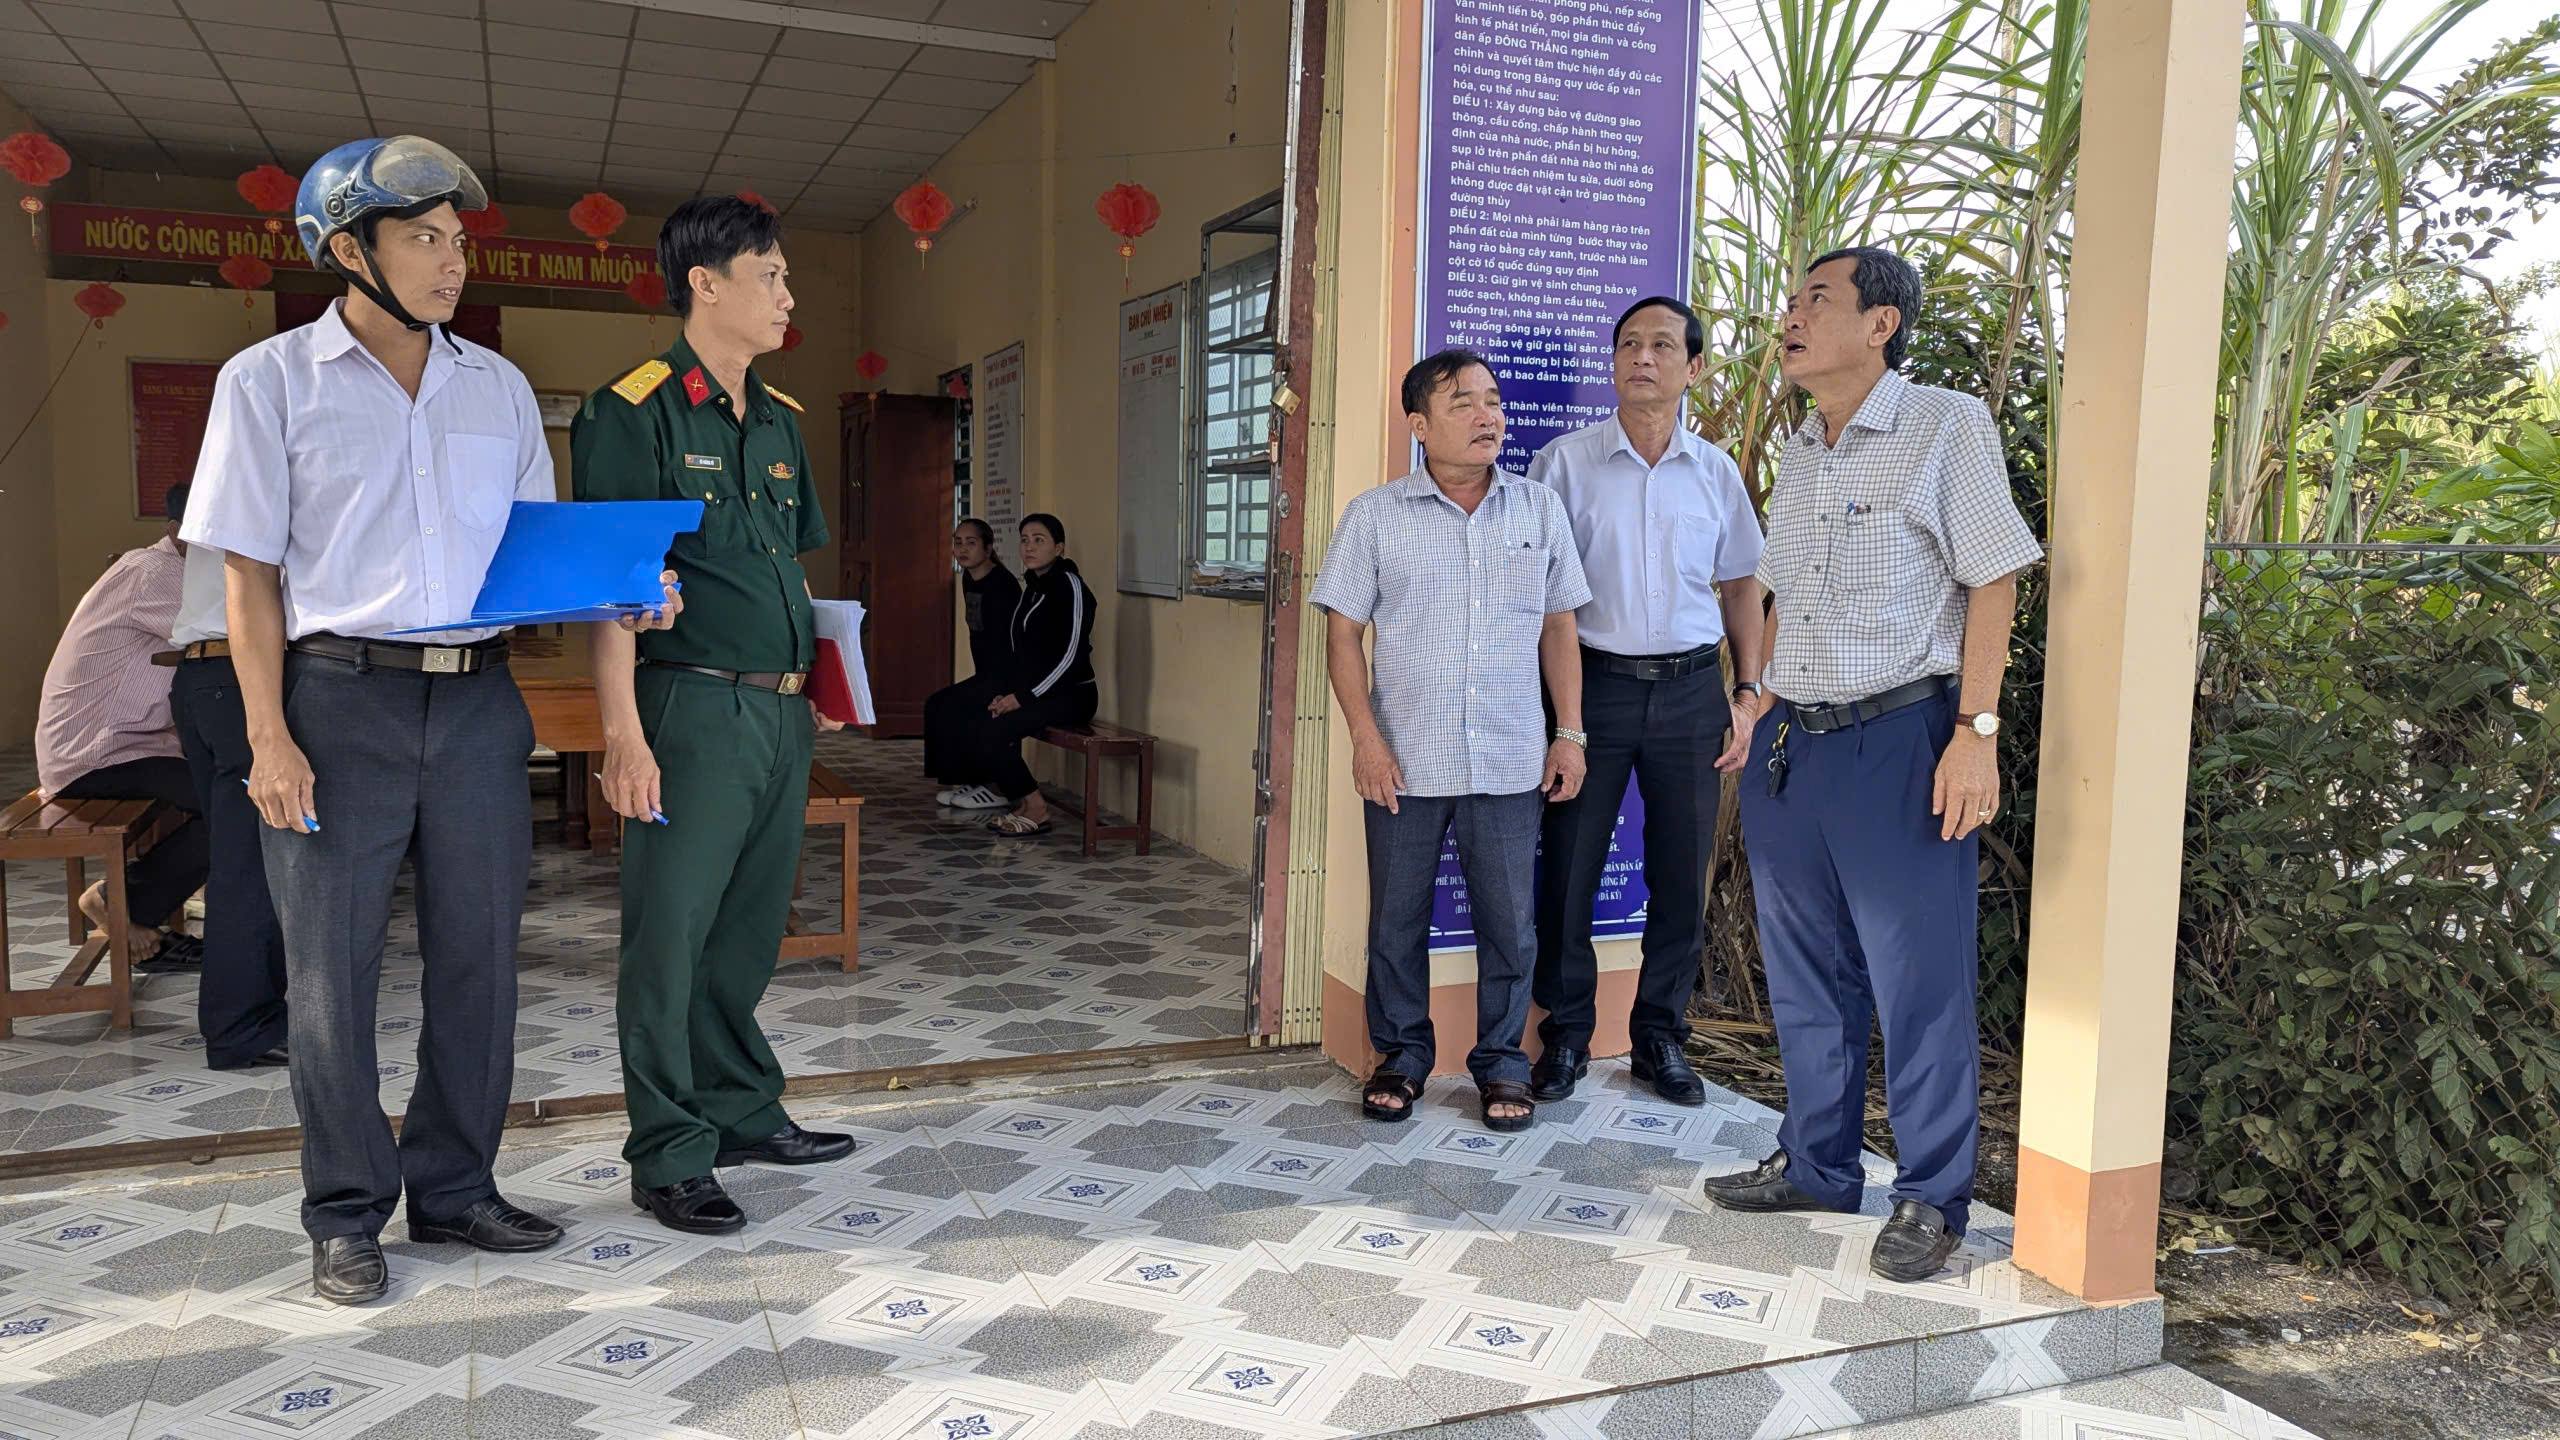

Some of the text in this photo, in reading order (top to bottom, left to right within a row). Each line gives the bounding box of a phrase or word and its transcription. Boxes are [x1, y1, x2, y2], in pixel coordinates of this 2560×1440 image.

[1478, 0, 1505, 14] minh
[1549, 11, 1570, 25] góp
[1601, 18, 1625, 31] thúc
[1590, 3, 1612, 14] phú,
[1454, 12, 1479, 26] kinh
[1494, 19, 1519, 32] phát
[1550, 29, 1571, 41] mọi
[1572, 31, 1589, 43] gia
[1616, 36, 1629, 48] và
[1631, 39, 1657, 54] công
[1454, 29, 1476, 42] dân
[1570, 47, 1610, 61] nghiêm
[1487, 50, 1500, 62] và
[1534, 57, 1554, 70] tâm
[1644, 72, 1663, 84] các
[1453, 78, 1537, 99] hóa, cụ như
[1473, 65, 1501, 80] dung
[1503, 69, 1532, 84] trong
[1563, 79, 1584, 91] quy
[1622, 85, 1641, 96] văn
[1483, 98, 1493, 109] 1:
[1495, 99, 1516, 114] Xây
[1547, 106, 1568, 118] bảo
[1619, 116, 1642, 128] giao
[1451, 111, 1487, 126] thông,
[1571, 125, 1598, 138] hành
[1599, 129, 1623, 141] theo
[1624, 133, 1644, 145] quy
[1451, 127, 1476, 140] định
[1478, 129, 1499, 142] của
[1500, 133, 1521, 145] nhà
[1583, 142, 1594, 155] bị
[1595, 143, 1610, 155] hư
[1451, 144, 1472, 157] sụp
[1487, 147, 1509, 159] trên
[1560, 156, 1580, 167] nhà
[1582, 158, 1602, 170] nào
[1619, 162, 1639, 174] nhà
[1641, 164, 1655, 175] đó
[1450, 159, 1475, 172] phải
[1477, 162, 1501, 175] chịu
[1502, 165, 1530, 177] trách
[1567, 172, 1578, 183] tu
[1628, 179, 1654, 193] sông
[1450, 175, 1485, 191] không
[1592, 190, 1615, 203] giao
[1616, 192, 1646, 207] thông
[1479, 210, 1651, 236] 2: Mọi nhà phải làm hàng trên
[228, 223, 274, 259] HÒA
[1499, 227, 1519, 239] của
[1520, 230, 1547, 242] mình
[1605, 238, 1628, 251] thay
[1629, 240, 1649, 251] vào
[1448, 239, 1477, 254] hàng
[1528, 246, 1547, 260] cây
[1548, 249, 1577, 262] xanh,
[1608, 253, 1627, 265] nhà
[1629, 255, 1648, 266] làm
[539, 254, 583, 282] NAM
[1525, 262, 1553, 276] đúng
[1554, 266, 1574, 278] quy
[1576, 266, 1599, 278] định
[1477, 273, 1488, 284] 3:
[1545, 279, 1568, 291] sinh
[1570, 281, 1602, 295] chung
[1604, 283, 1624, 295] bảo
[1476, 290, 1506, 303] sạch,
[1507, 291, 1541, 306] không
[1542, 294, 1562, 305] làm
[1585, 297, 1608, 310] tiêu,
[1128, 313, 1140, 332] BAN
[1489, 306, 1616, 326] trại, nhà và rác,
[1504, 323, 1531, 336] sông
[1532, 324, 1553, 338] gây
[1554, 325, 1562, 336] ô
[1475, 336, 1486, 347] 4:
[1488, 336, 1509, 348] bảo
[1563, 341, 1577, 353] tài
[1579, 342, 1598, 354] sản
[1487, 352, 1511, 364] kinh
[1550, 356, 1561, 369] bị
[1498, 368, 1513, 380] đê
[1514, 369, 1535, 381] bao
[1560, 372, 1581, 383] bảo
[1582, 374, 1609, 386] phục
[1509, 400, 1540, 412] thành
[1541, 401, 1564, 413] viên
[1565, 403, 1593, 416] trong
[1594, 404, 1611, 417] gia
[1517, 415, 1537, 426] bảo
[1539, 416, 1564, 427] hiểm
[1567, 420, 1573, 430] y
[1507, 447, 1529, 458] nhà,
[1506, 462, 1525, 472] hòa
